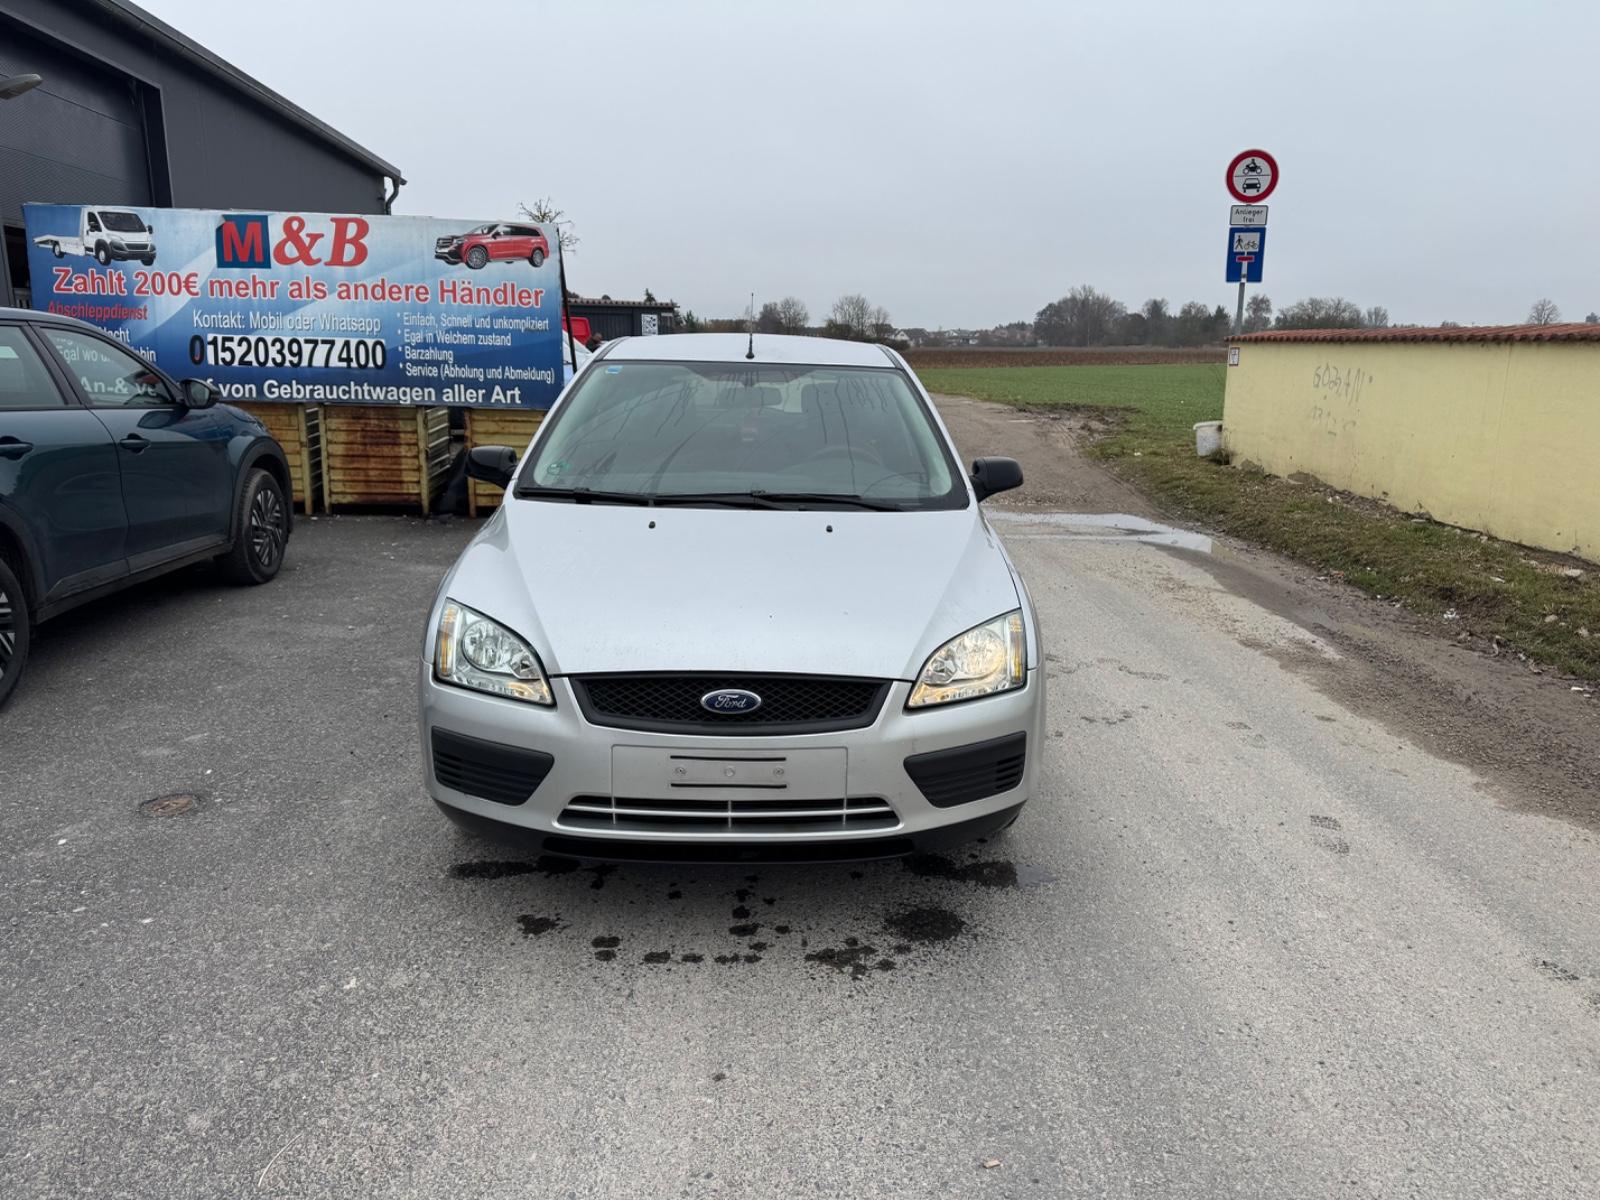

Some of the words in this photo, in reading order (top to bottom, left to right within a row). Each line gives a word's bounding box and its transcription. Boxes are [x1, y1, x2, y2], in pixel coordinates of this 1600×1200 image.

[1235, 209, 1263, 217] Anlieger
[1243, 215, 1255, 223] frei
[52, 267, 126, 295] Zahlt
[133, 270, 200, 297] 200€
[208, 274, 280, 299] mehr
[288, 276, 327, 299] als
[336, 277, 430, 303] andere
[438, 279, 544, 308] Händler
[193, 309, 245, 329] Kontakt:
[250, 311, 283, 330] Mobil
[287, 312, 315, 330] oder
[319, 313, 381, 334] Whatsapp
[403, 312, 438, 328] Einfach,
[440, 313, 472, 328] Schnell
[475, 315, 490, 328] und
[493, 316, 549, 331] unkompliziert
[404, 329, 423, 345] Egal
[426, 330, 434, 343] in
[436, 330, 475, 345] Welchem
[478, 332, 511, 346] zustand
[189, 335, 386, 369] 015203977400
[404, 346, 453, 363] Barzahlung
[406, 363, 438, 376] Service
[440, 364, 484, 381] (Abholung
[486, 365, 502, 379] und
[504, 366, 554, 384] Abmeldung)
[219, 383, 256, 398] von
[263, 379, 435, 404] Gebrauchtwagen
[442, 383, 486, 403] aller
[491, 385, 522, 404] Art
[715, 694, 747, 708] Ford
